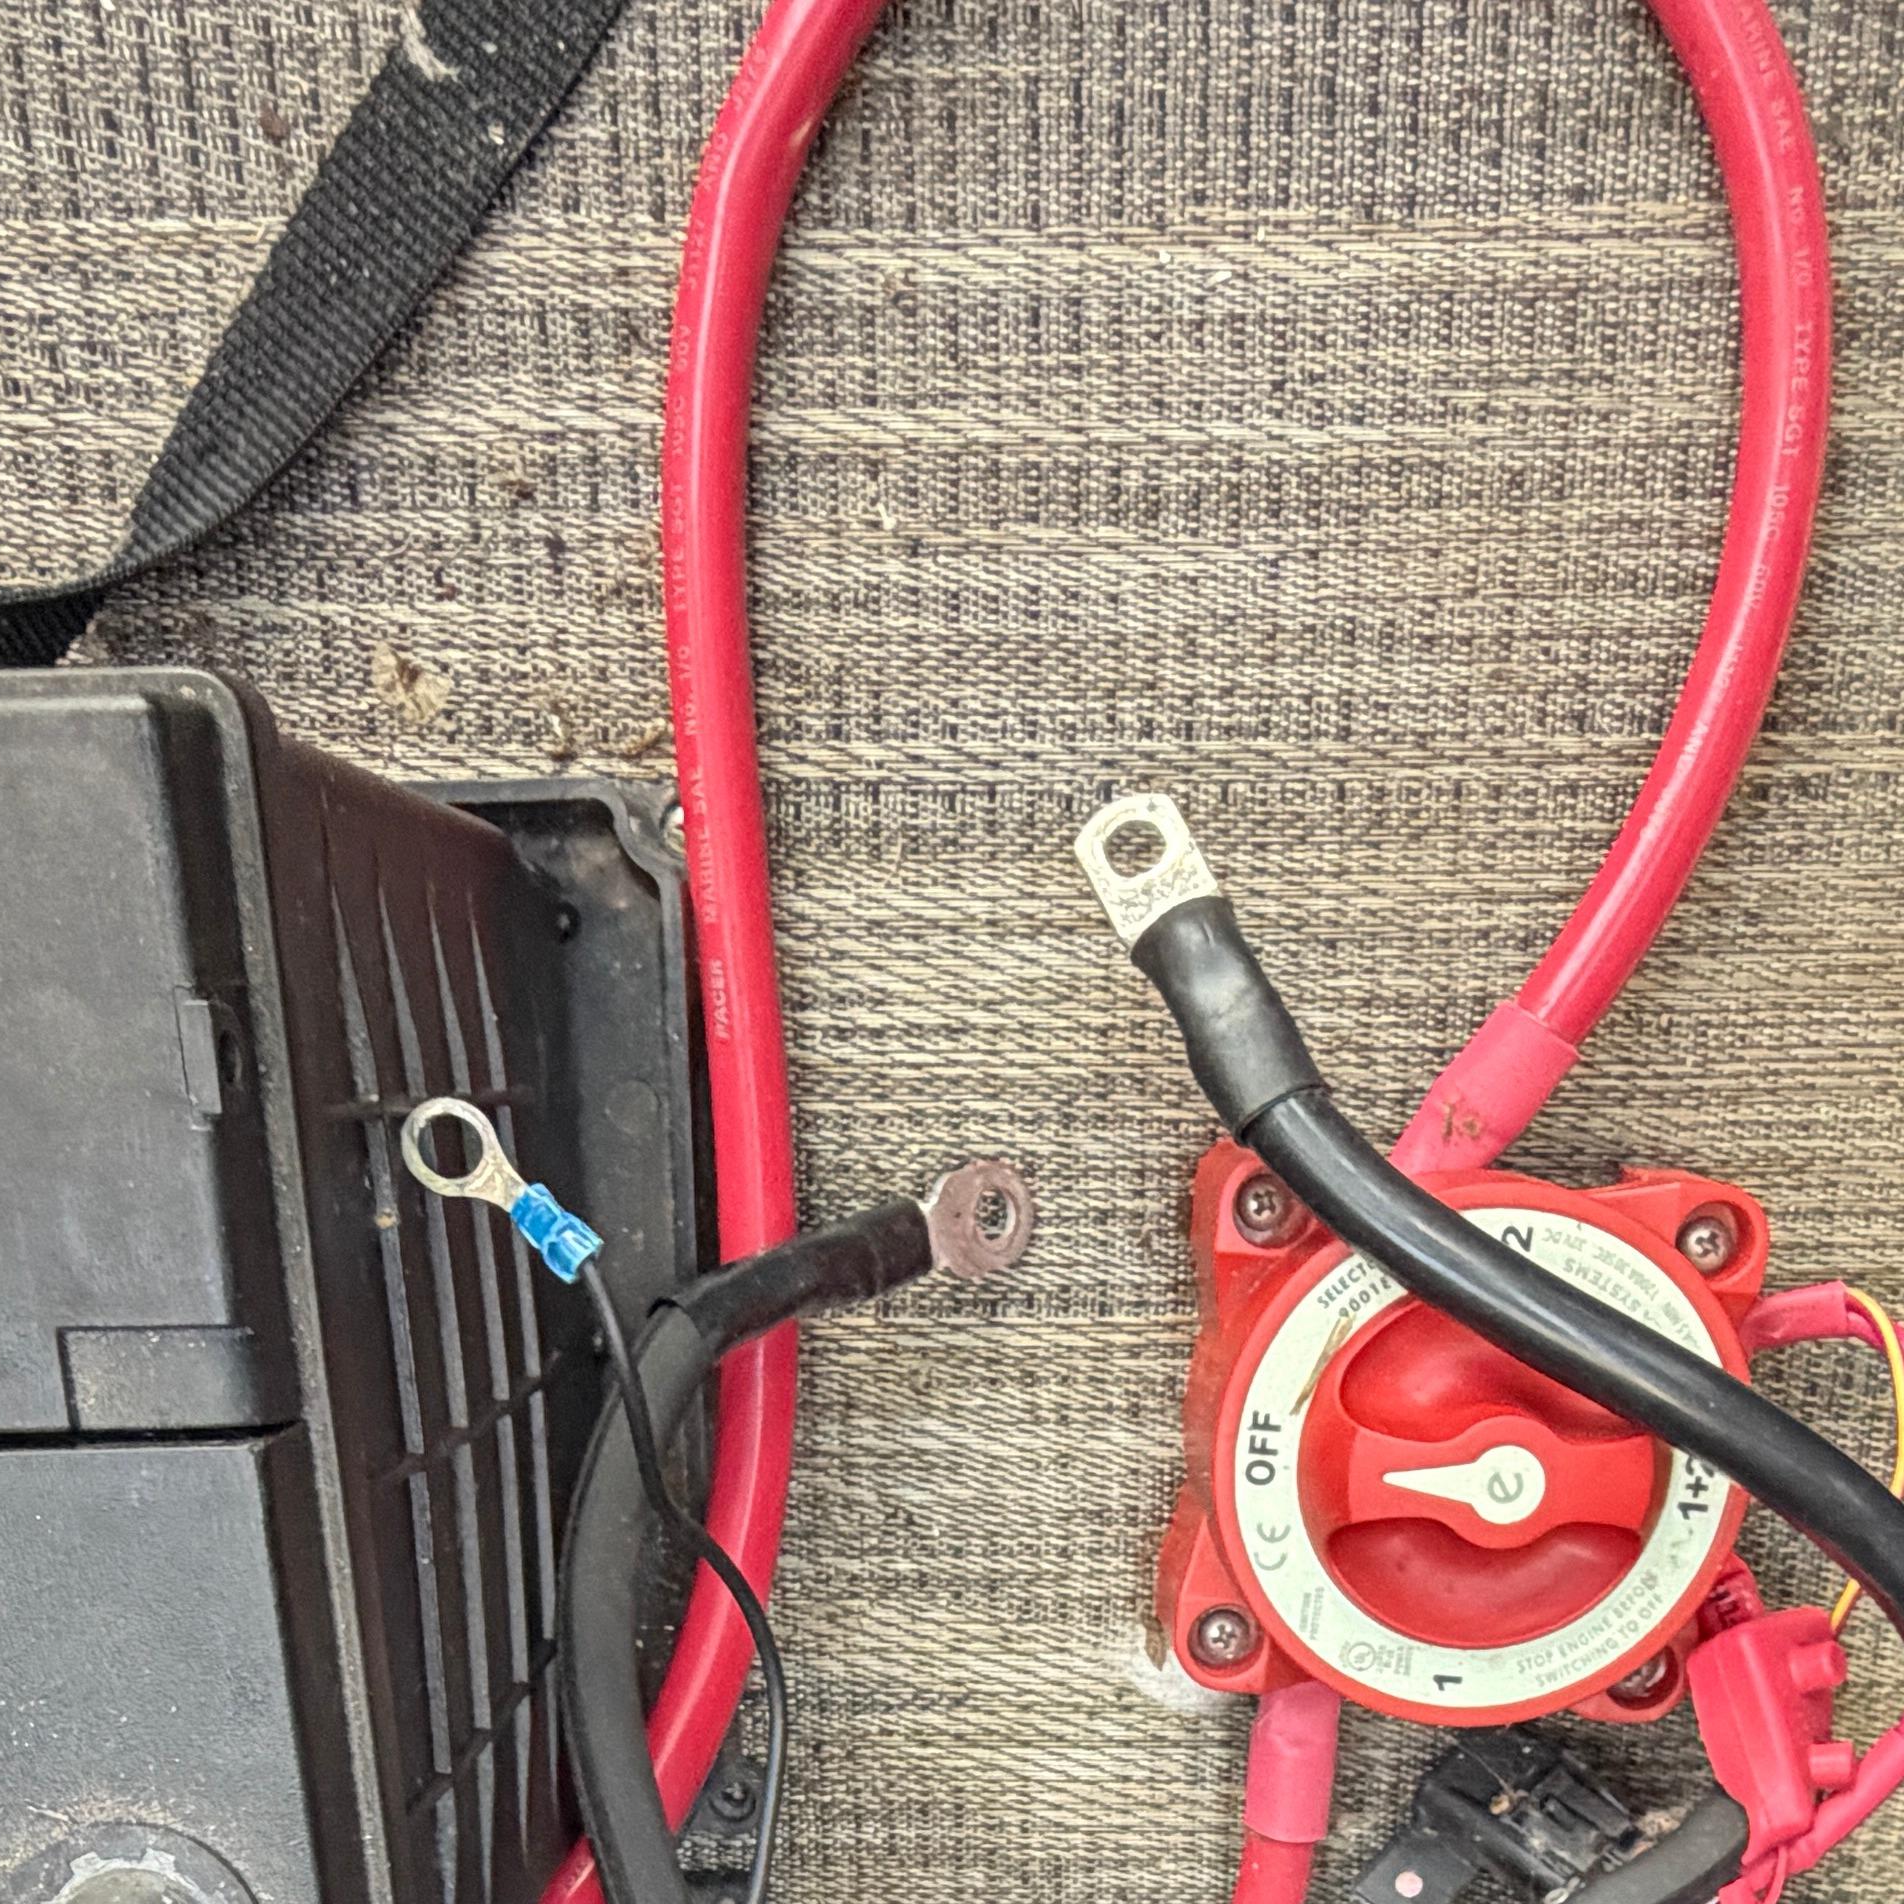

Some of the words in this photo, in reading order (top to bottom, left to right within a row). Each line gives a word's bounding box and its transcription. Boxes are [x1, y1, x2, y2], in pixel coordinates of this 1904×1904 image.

[709, 959, 730, 1039] PACER
[1501, 1225, 1534, 1253] 2
[1245, 1410, 1281, 1486] OFF
[1516, 1649, 1553, 1674] STOP
[1433, 1674, 1463, 1691] 1
